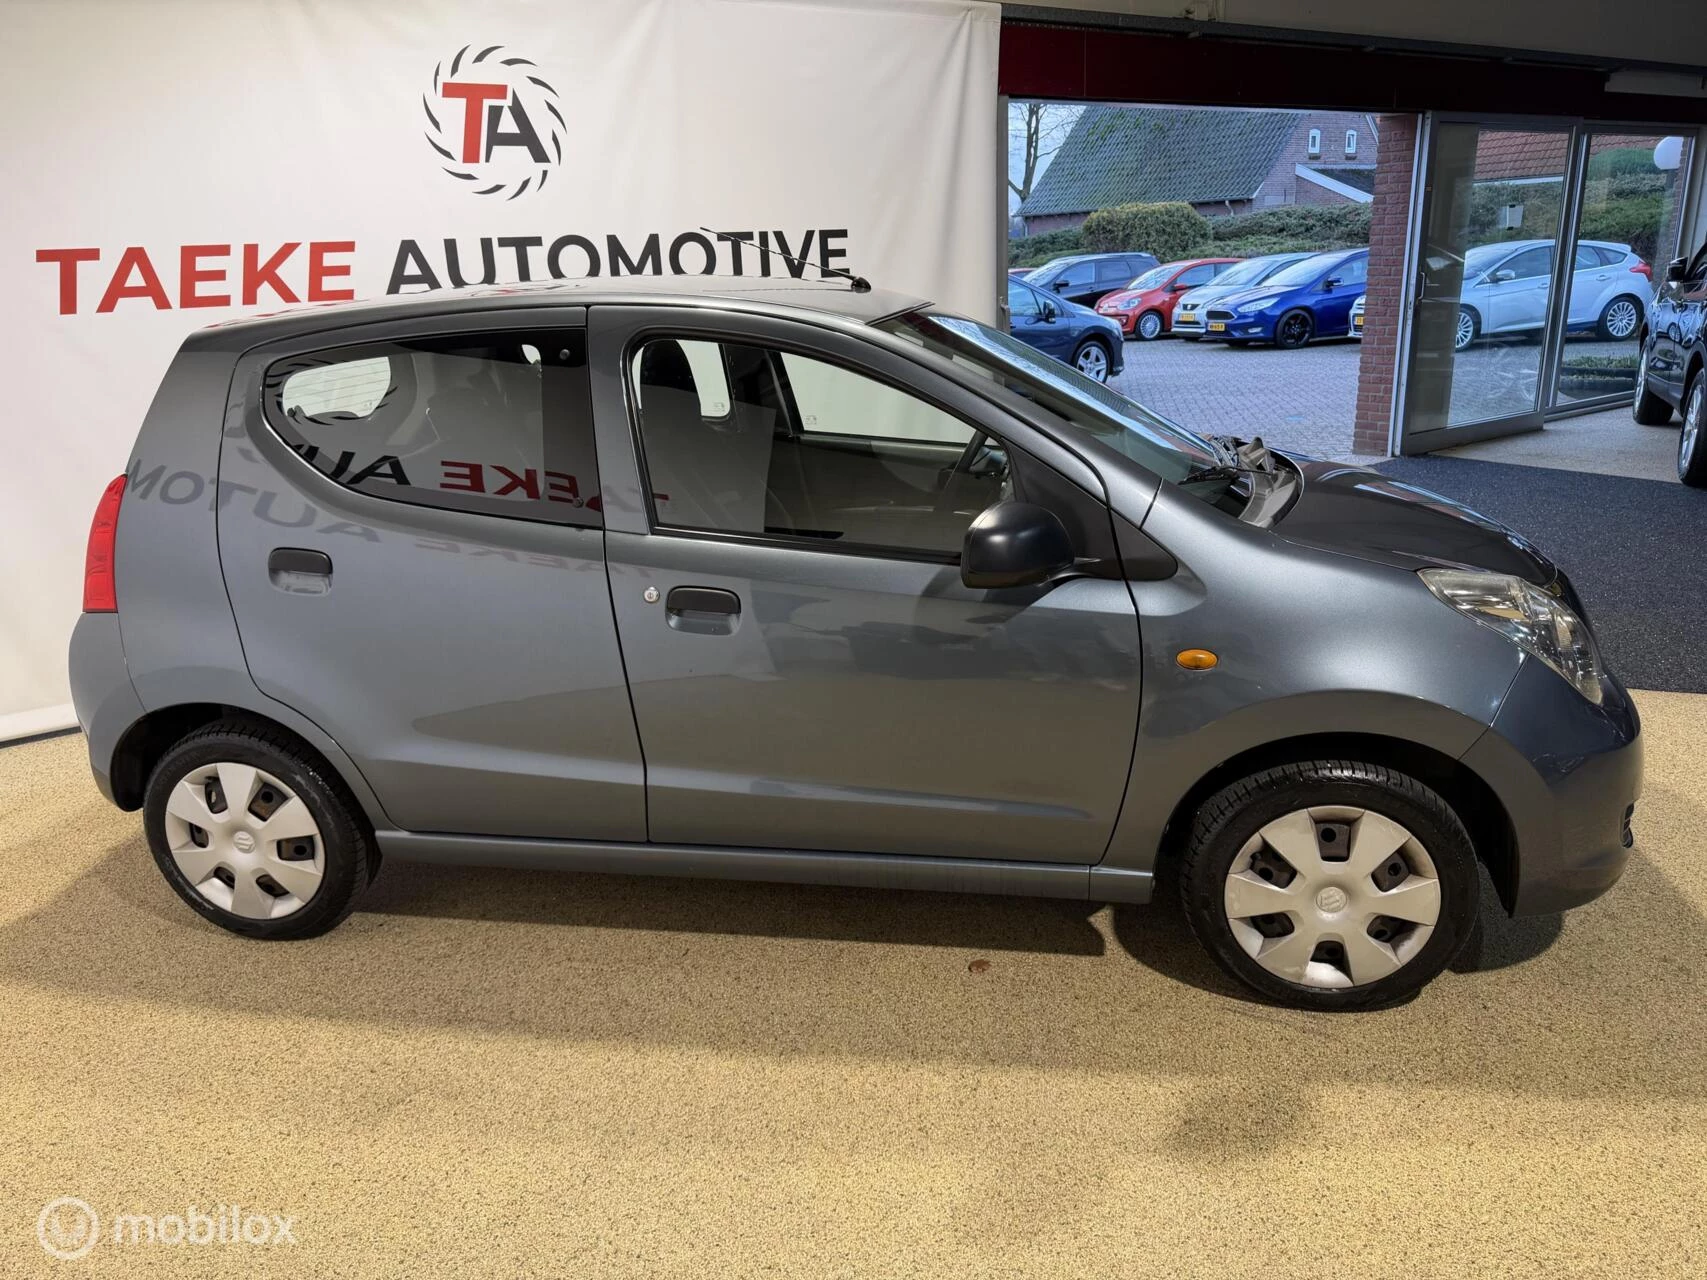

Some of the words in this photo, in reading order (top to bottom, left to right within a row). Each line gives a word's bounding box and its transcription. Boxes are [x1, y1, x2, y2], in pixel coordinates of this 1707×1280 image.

[442, 82, 552, 164] TA
[36, 241, 356, 315] TAEKE
[386, 228, 850, 295] AUTOMOTIVE
